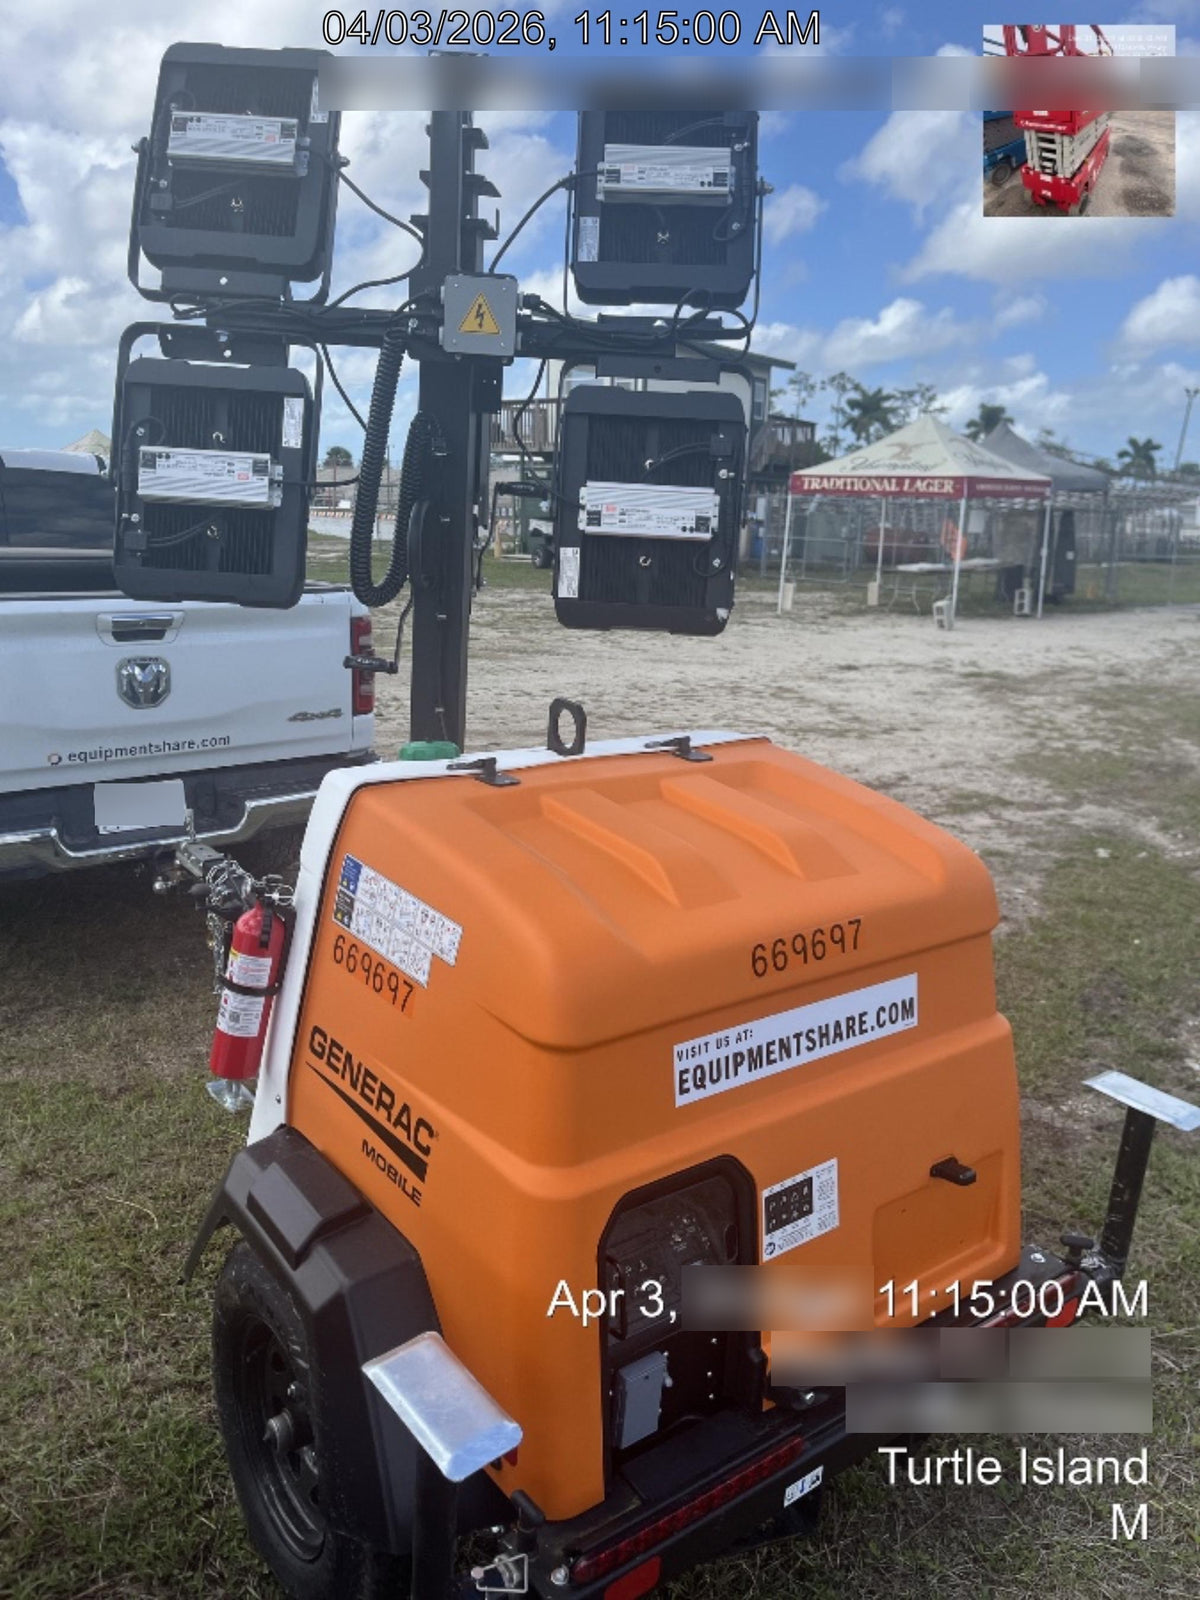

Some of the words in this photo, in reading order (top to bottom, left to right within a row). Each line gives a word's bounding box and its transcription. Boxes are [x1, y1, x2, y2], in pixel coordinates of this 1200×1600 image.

[802, 477, 899, 492] TRADITIONAL
[903, 478, 954, 493] LAGER
[67, 735, 231, 764] equipmentshare.com
[333, 934, 414, 1014] 669697
[751, 918, 862, 977] 669697
[677, 1041, 710, 1063] VISIT
[715, 1034, 730, 1051] US
[735, 1028, 754, 1045] AT:
[677, 996, 915, 1096] EQUIPMENTSHARE.COM
[308, 1024, 436, 1157] GENERAC
[361, 1139, 422, 1208] MOBILE
